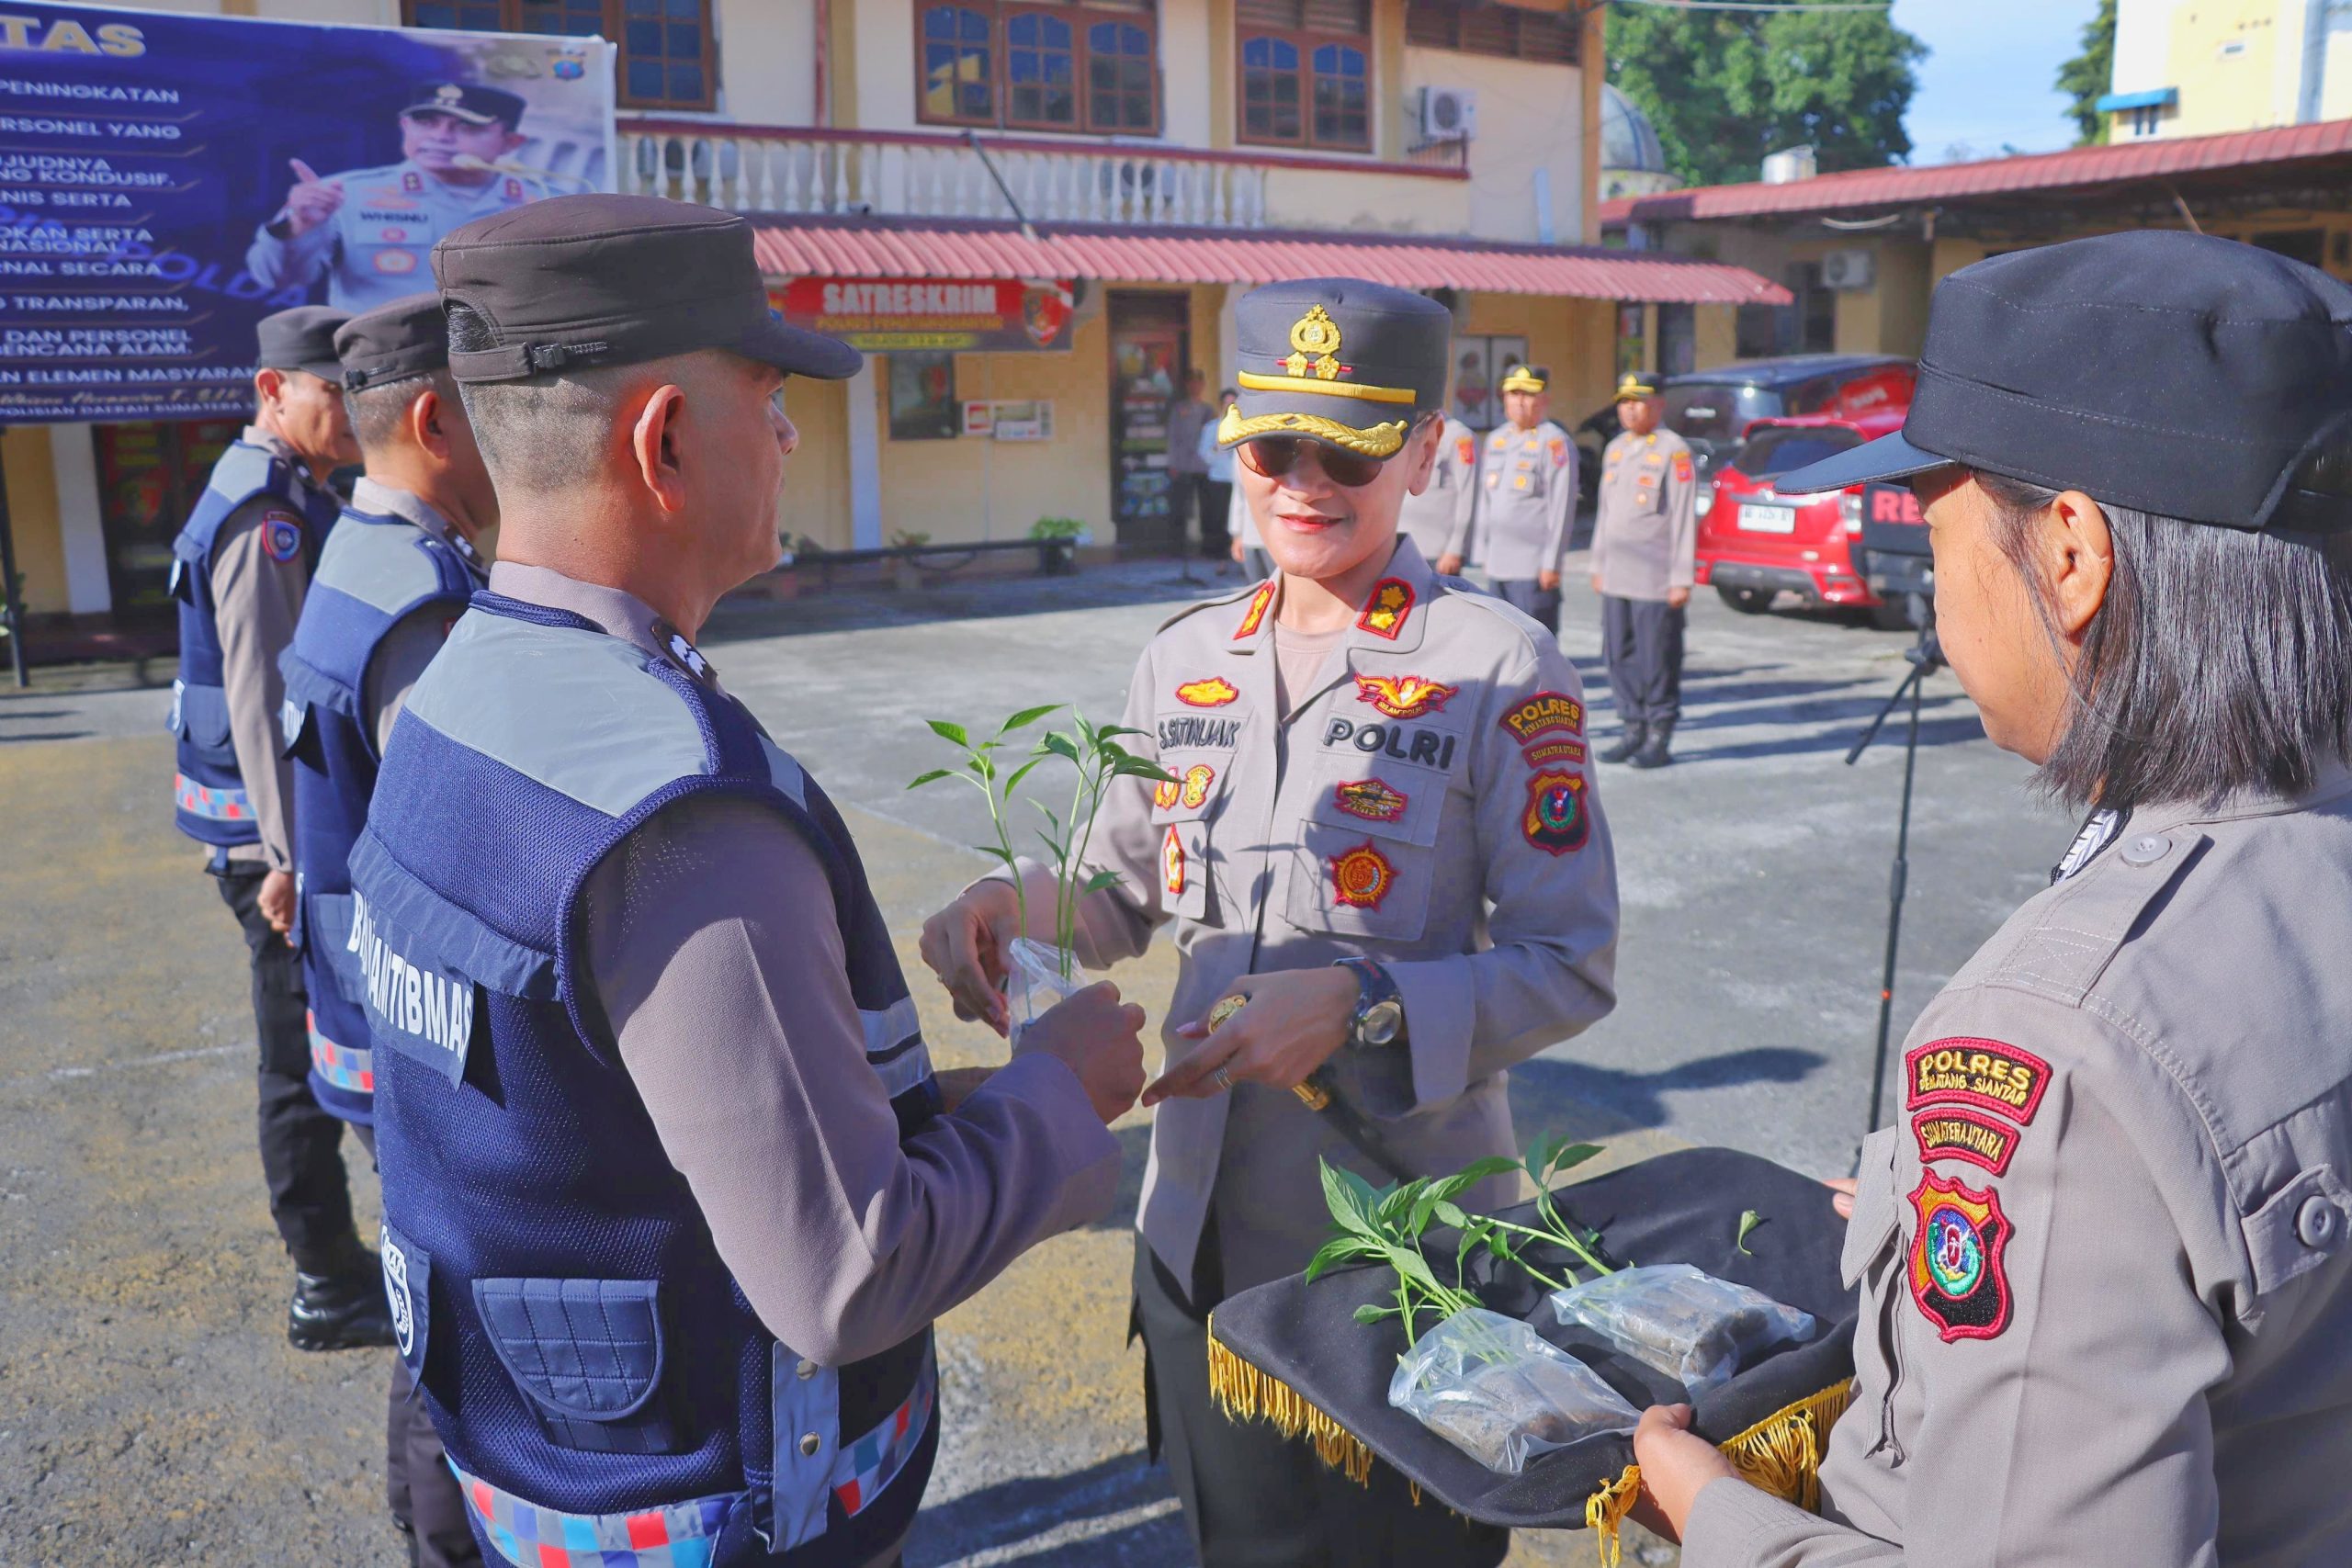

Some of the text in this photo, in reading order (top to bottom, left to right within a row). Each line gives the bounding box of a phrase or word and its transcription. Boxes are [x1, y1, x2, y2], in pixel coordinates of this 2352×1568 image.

[0, 15, 146, 57] TAS
[0, 154, 111, 172] JUDNYA
[0, 190, 132, 208] NIS SERTA
[74, 227, 154, 243] SERTA
[0, 260, 163, 276] NAL SECARA
[822, 283, 996, 314] SATRESKRIM
[6, 329, 192, 344] DAN PERSONEL
[0, 344, 111, 356] ENCANA
[27, 369, 121, 383] ELEMEN
[1508, 698, 1580, 730] POLRES
[1323, 717, 1455, 770] POLRI
[1919, 1050, 2032, 1090] POLRES
